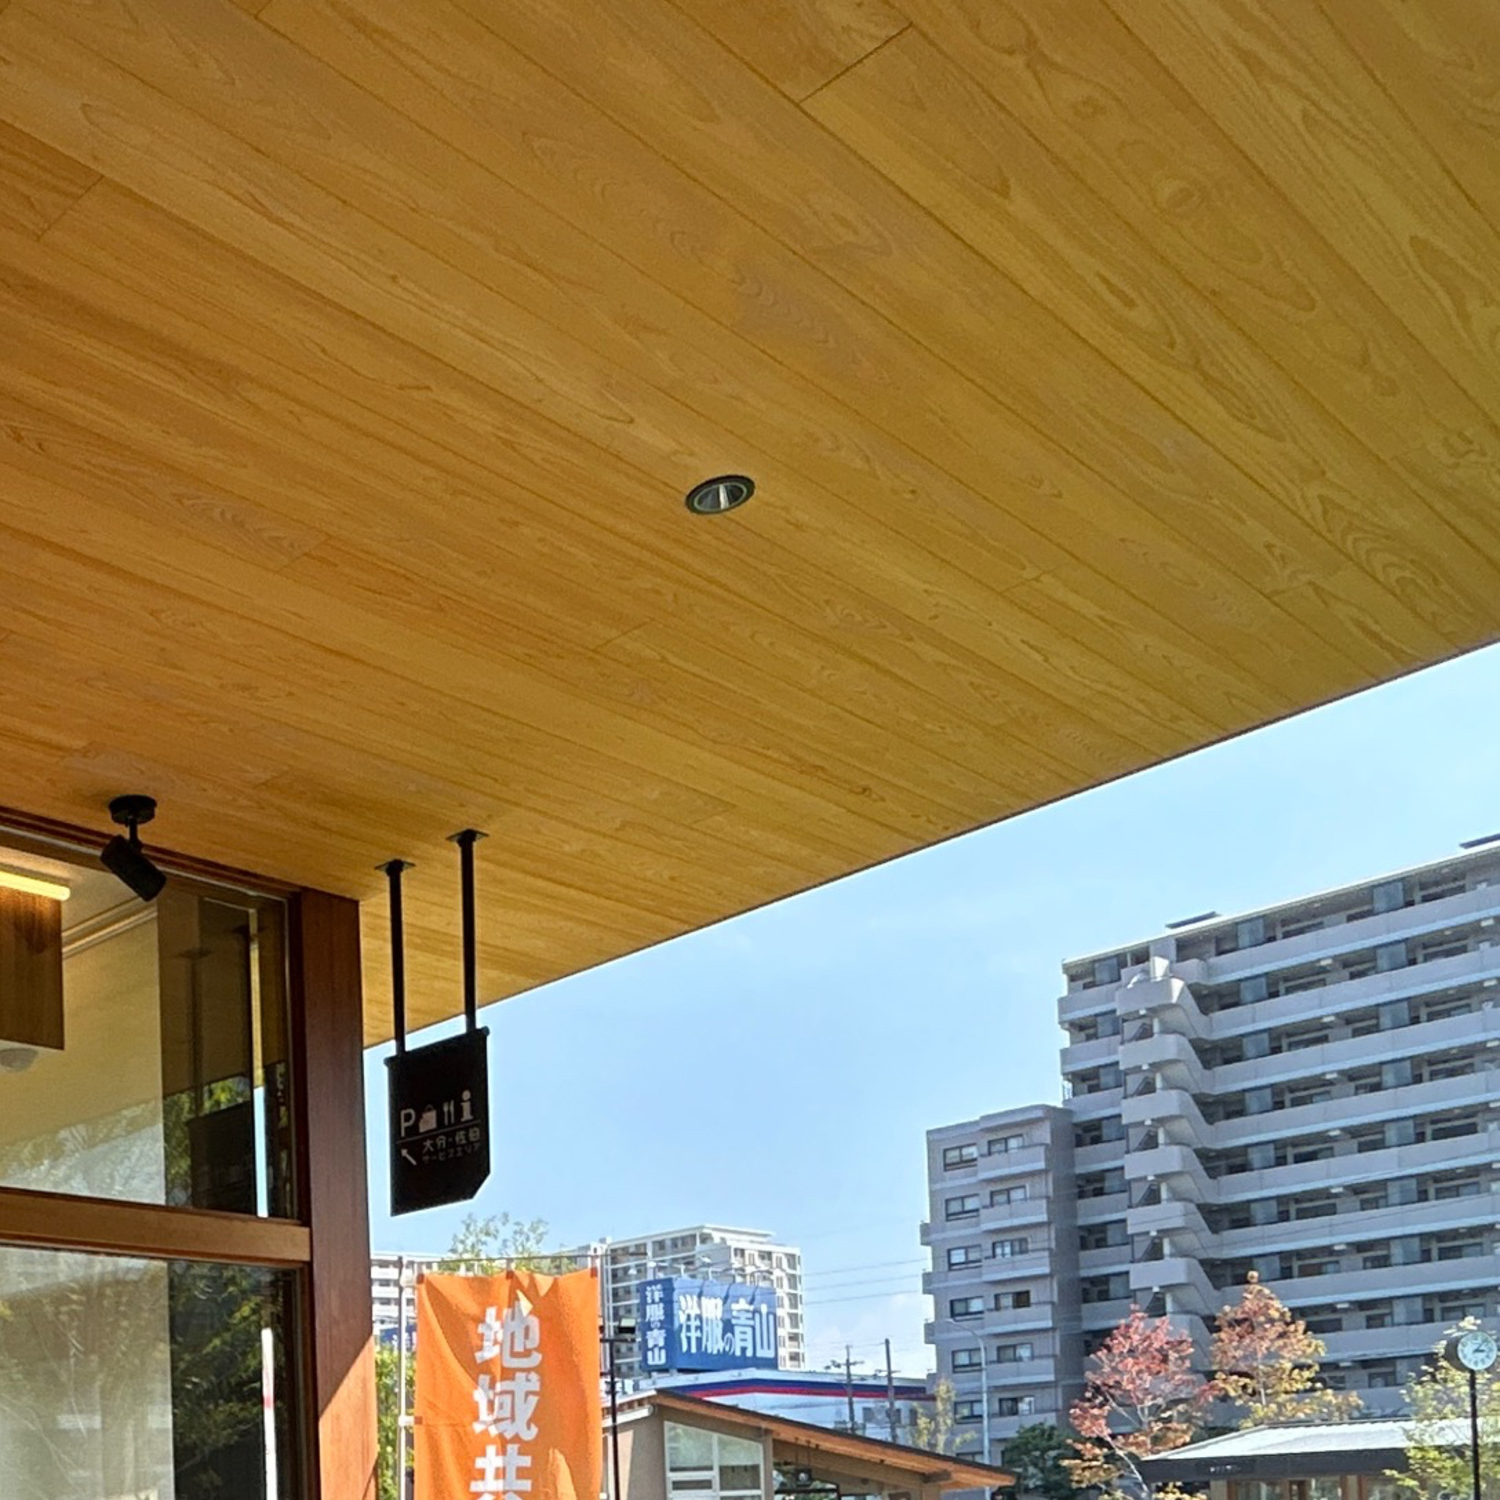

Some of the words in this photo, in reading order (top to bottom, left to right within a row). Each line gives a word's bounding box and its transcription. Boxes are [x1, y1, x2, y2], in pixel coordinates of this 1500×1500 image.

[401, 1108, 416, 1137] P
[645, 1284, 667, 1366] 洋服の青山
[678, 1293, 775, 1359] 洋服の青山
